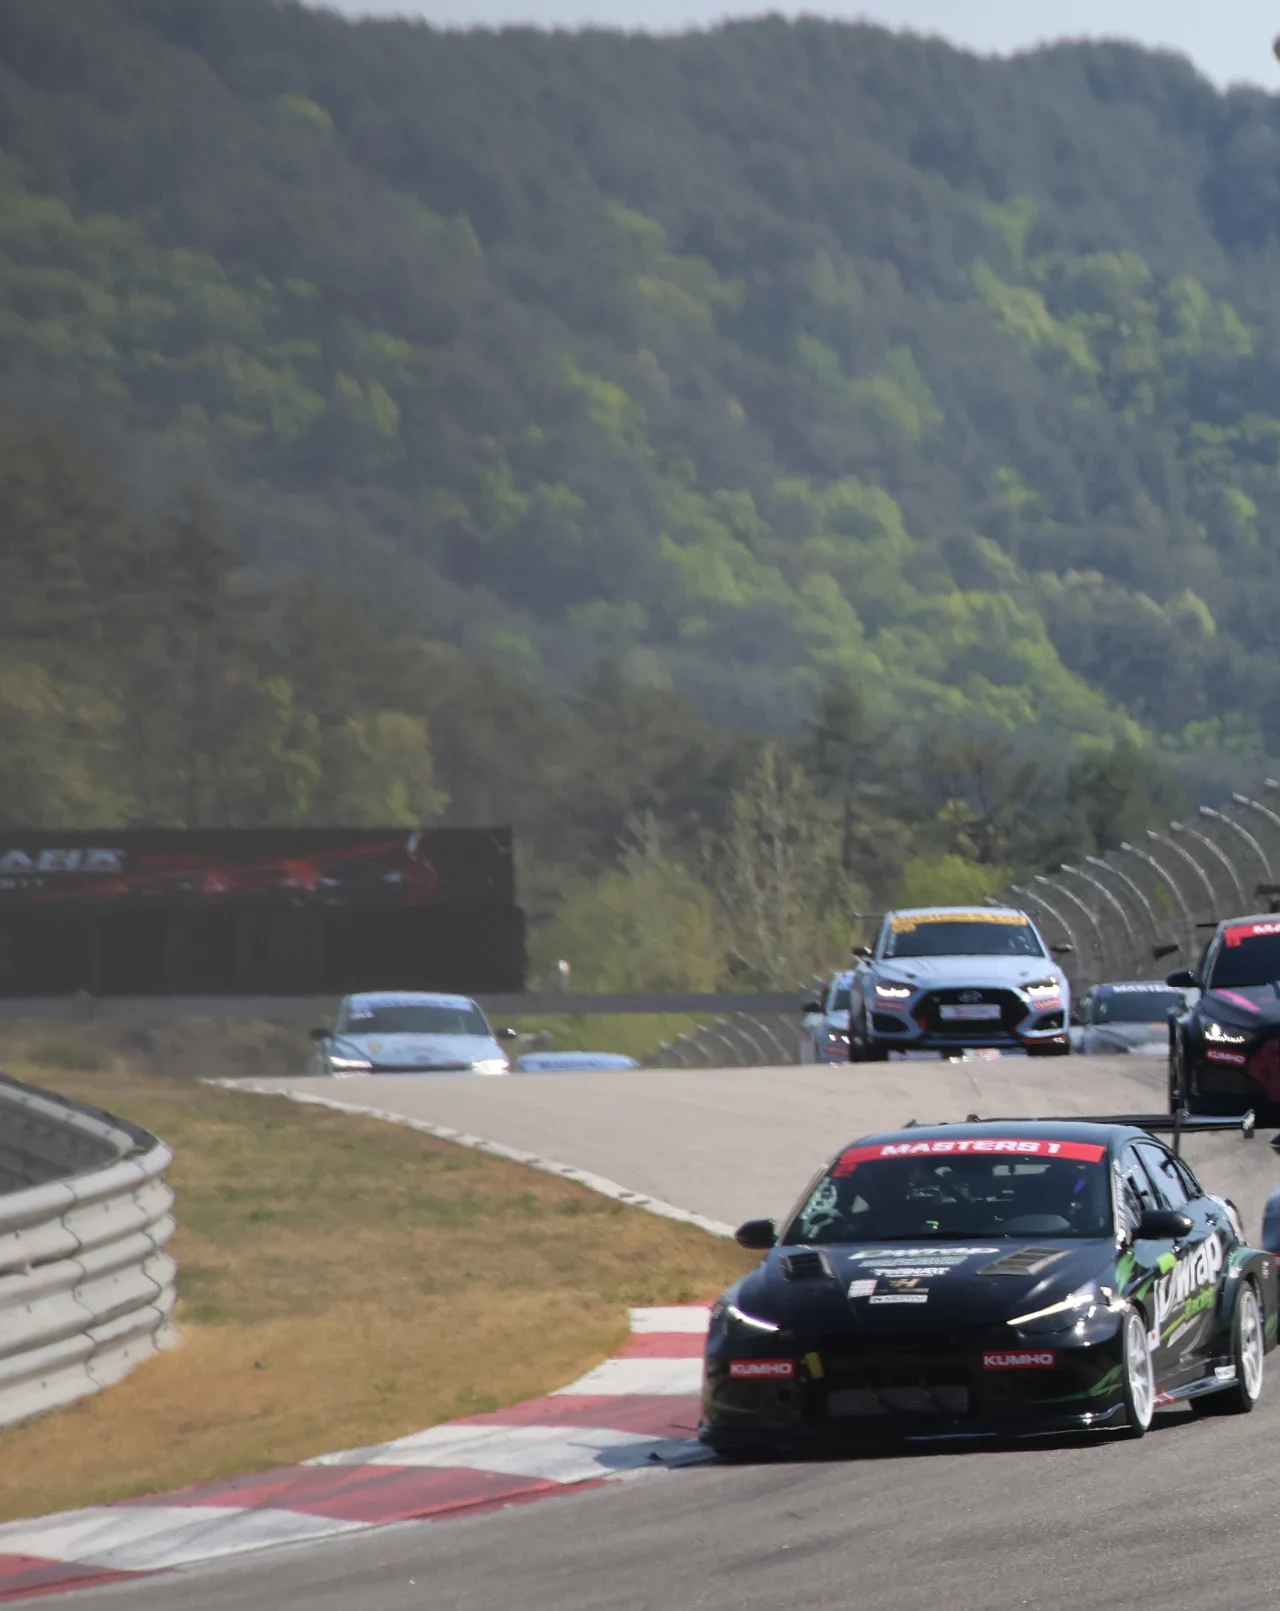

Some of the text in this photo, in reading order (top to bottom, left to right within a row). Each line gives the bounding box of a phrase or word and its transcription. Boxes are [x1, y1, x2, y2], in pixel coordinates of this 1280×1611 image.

[1207, 1050, 1246, 1063] KUMHO
[880, 1140, 1062, 1156] MASTERS 1
[983, 1353, 1055, 1367] KUMHO
[729, 1363, 793, 1376] KUMHO
